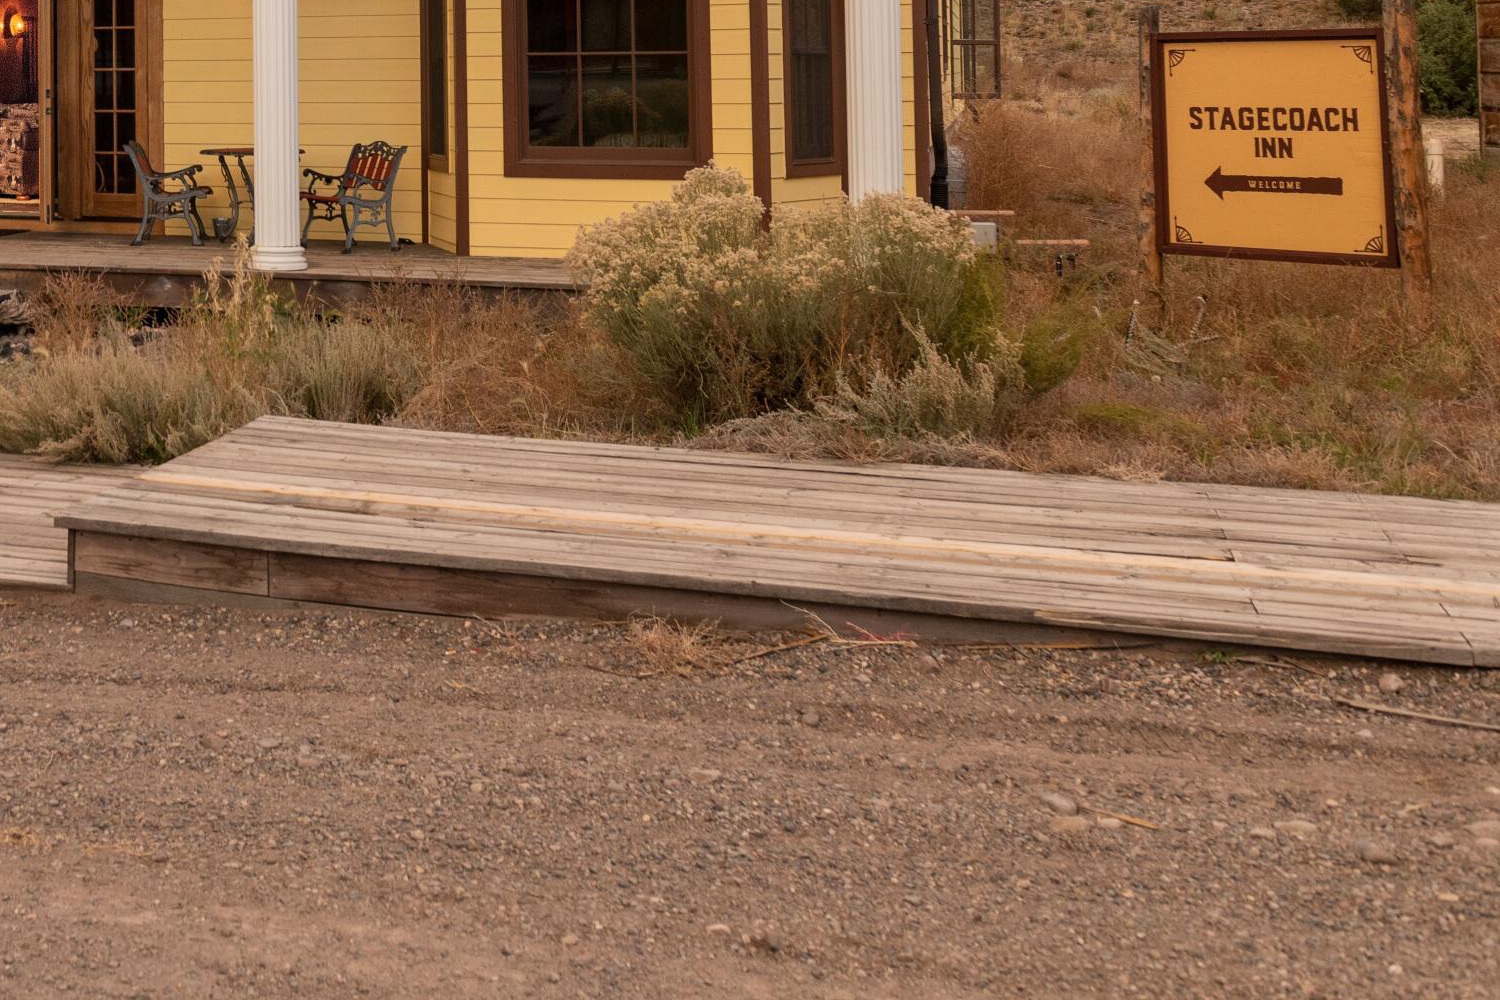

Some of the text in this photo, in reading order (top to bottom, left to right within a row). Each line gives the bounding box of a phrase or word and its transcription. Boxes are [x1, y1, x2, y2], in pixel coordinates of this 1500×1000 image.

[1188, 106, 1360, 132] STAGECOACH
[1253, 136, 1294, 159] INN
[1247, 179, 1302, 190] WELCOME
